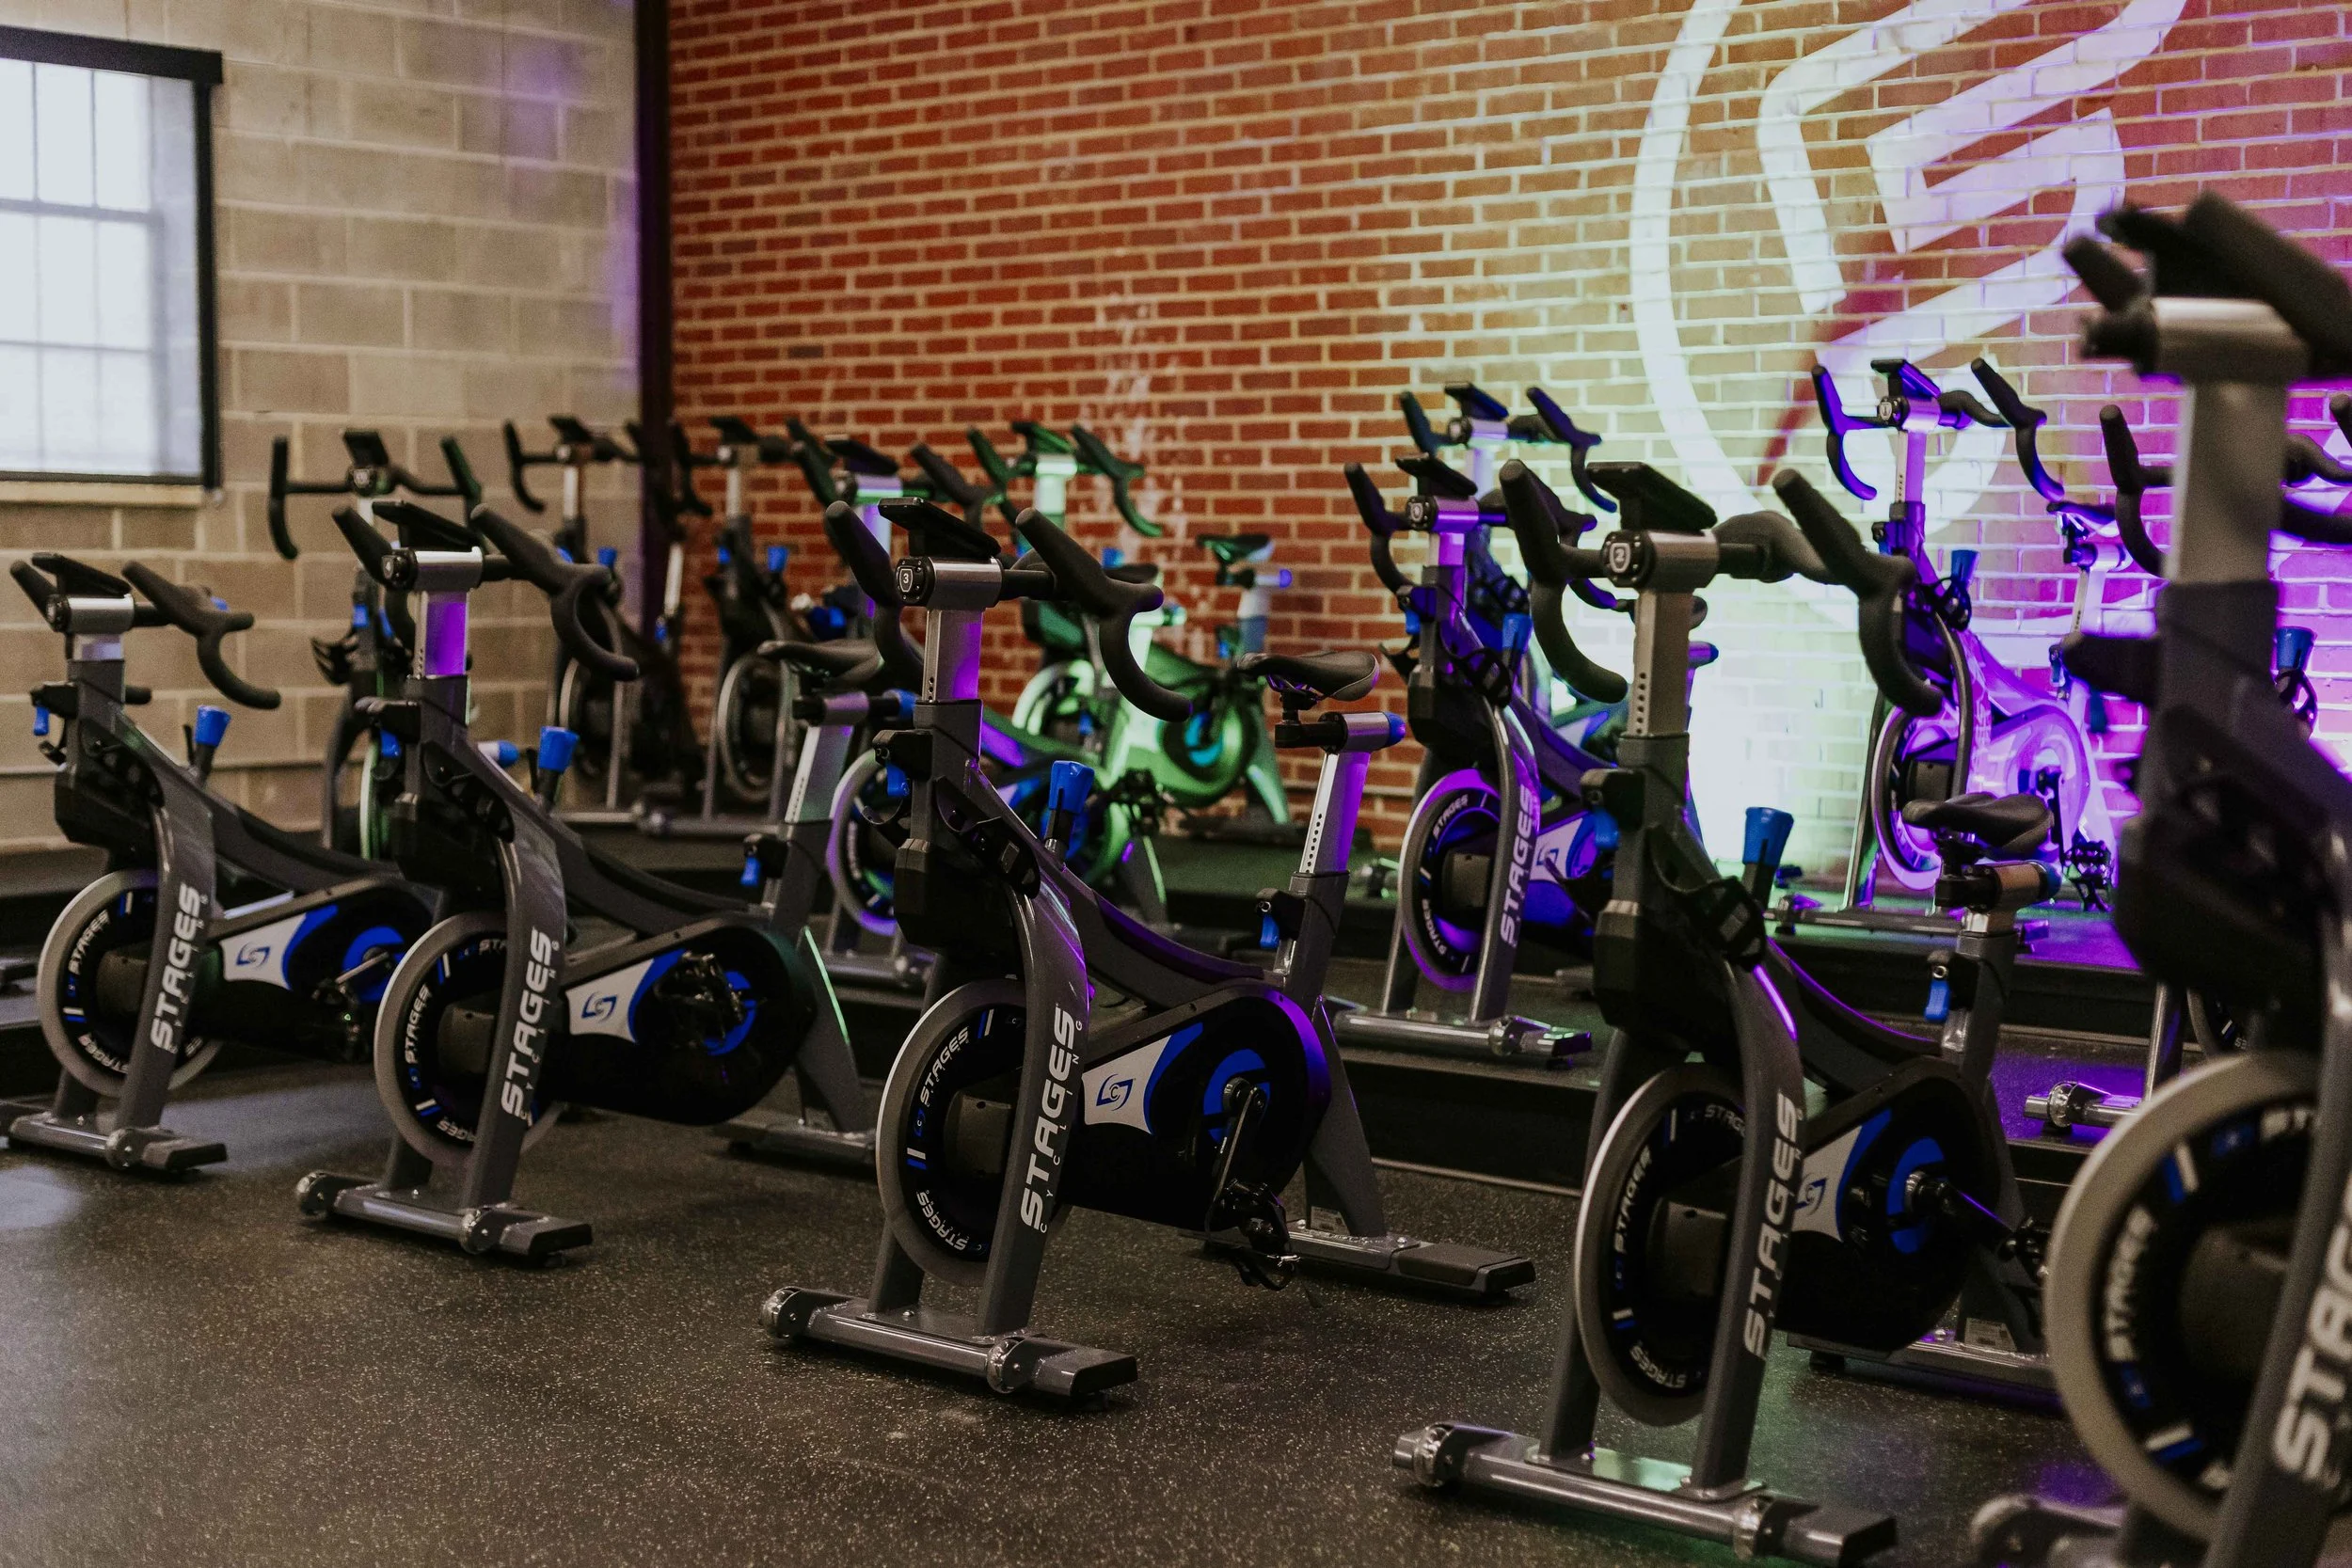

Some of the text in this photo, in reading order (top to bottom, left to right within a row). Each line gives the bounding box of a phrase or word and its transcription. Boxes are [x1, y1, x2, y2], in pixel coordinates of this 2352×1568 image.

[903, 573, 909, 583] 3
[1615, 548, 1624, 562] 2
[1500, 784, 1534, 945] STAGES
[151, 882, 200, 1051] STAGES
[501, 926, 552, 1117] STAGES
[920, 1026, 969, 1106] STAGES
[1021, 1006, 1074, 1230] STAGES
[1040, 1021, 1083, 1233] CYCLING
[916, 1191, 969, 1251] STAGES
[1743, 1092, 1797, 1359] STAGES
